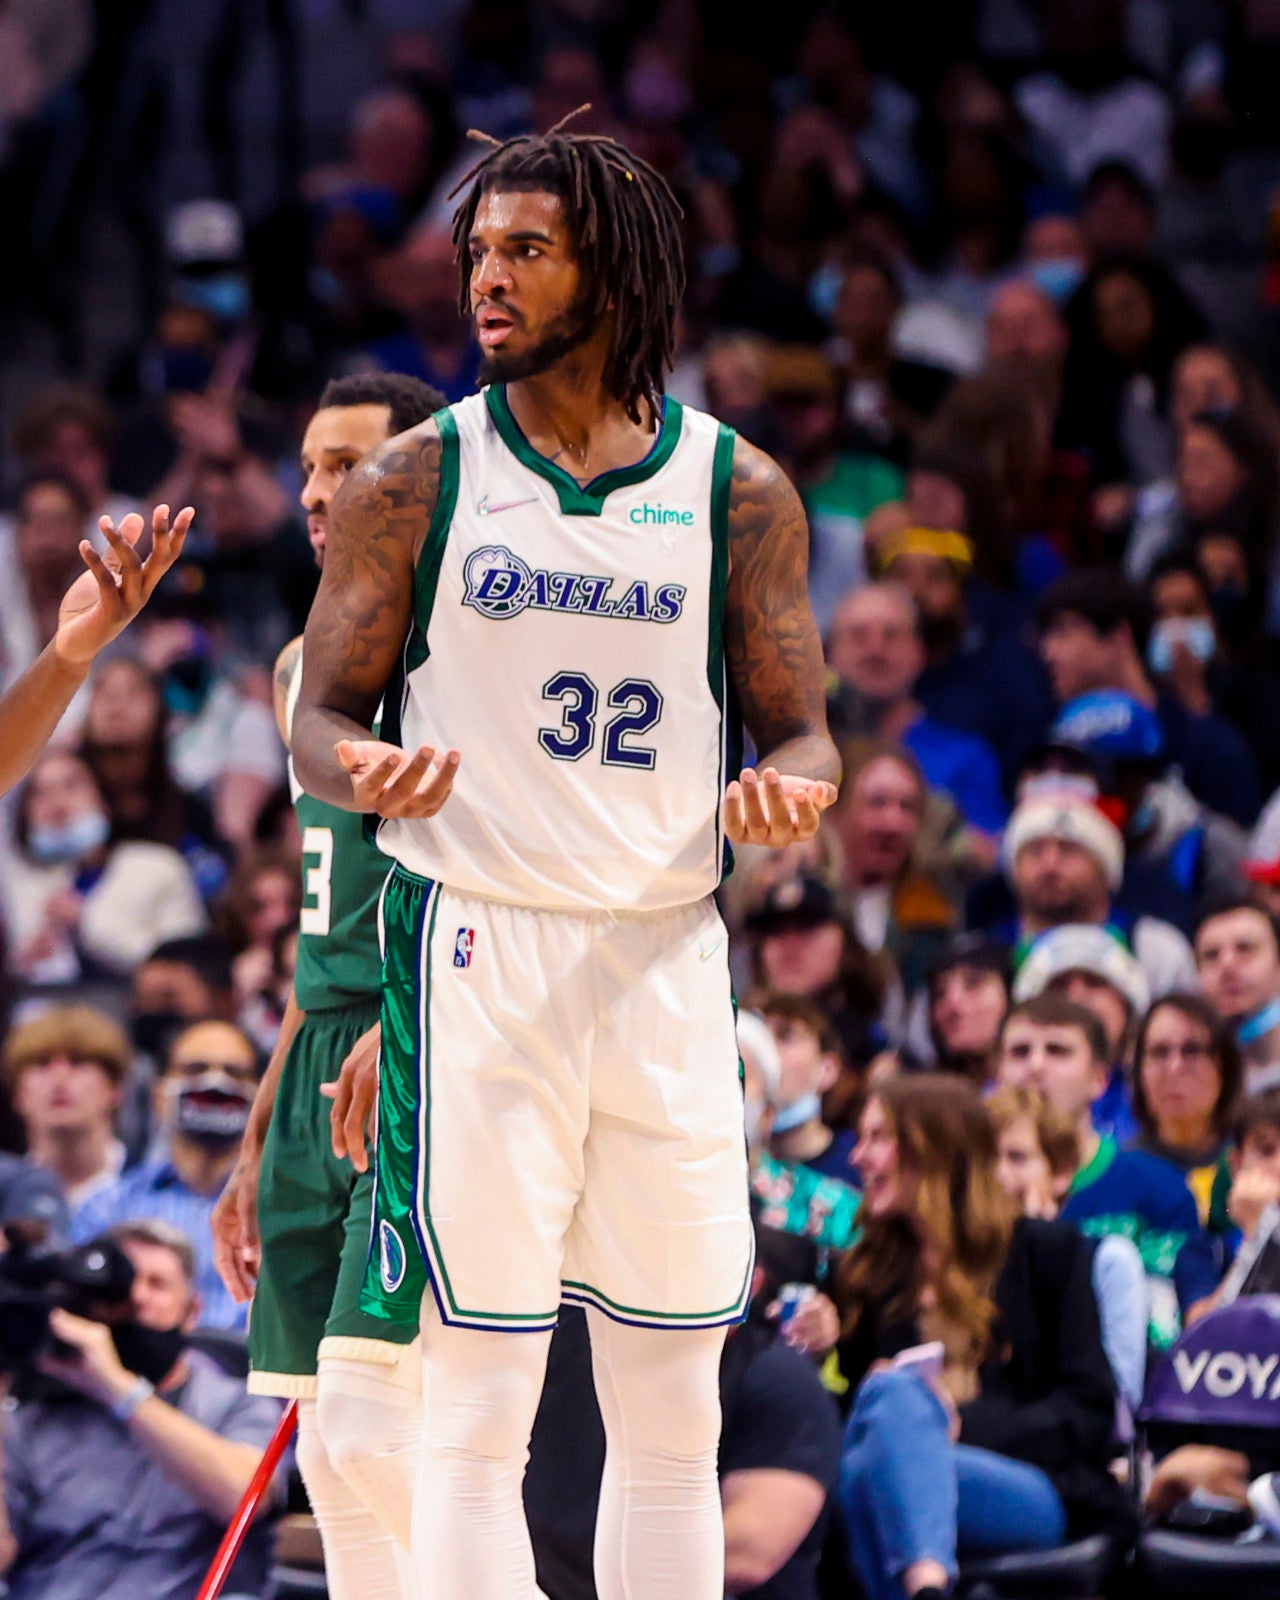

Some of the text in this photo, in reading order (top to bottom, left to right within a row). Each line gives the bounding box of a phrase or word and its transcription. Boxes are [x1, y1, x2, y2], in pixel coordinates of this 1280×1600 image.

[629, 502, 694, 526] chime
[461, 568, 687, 624] DALLAS
[538, 670, 664, 771] 32
[300, 826, 334, 936] 3
